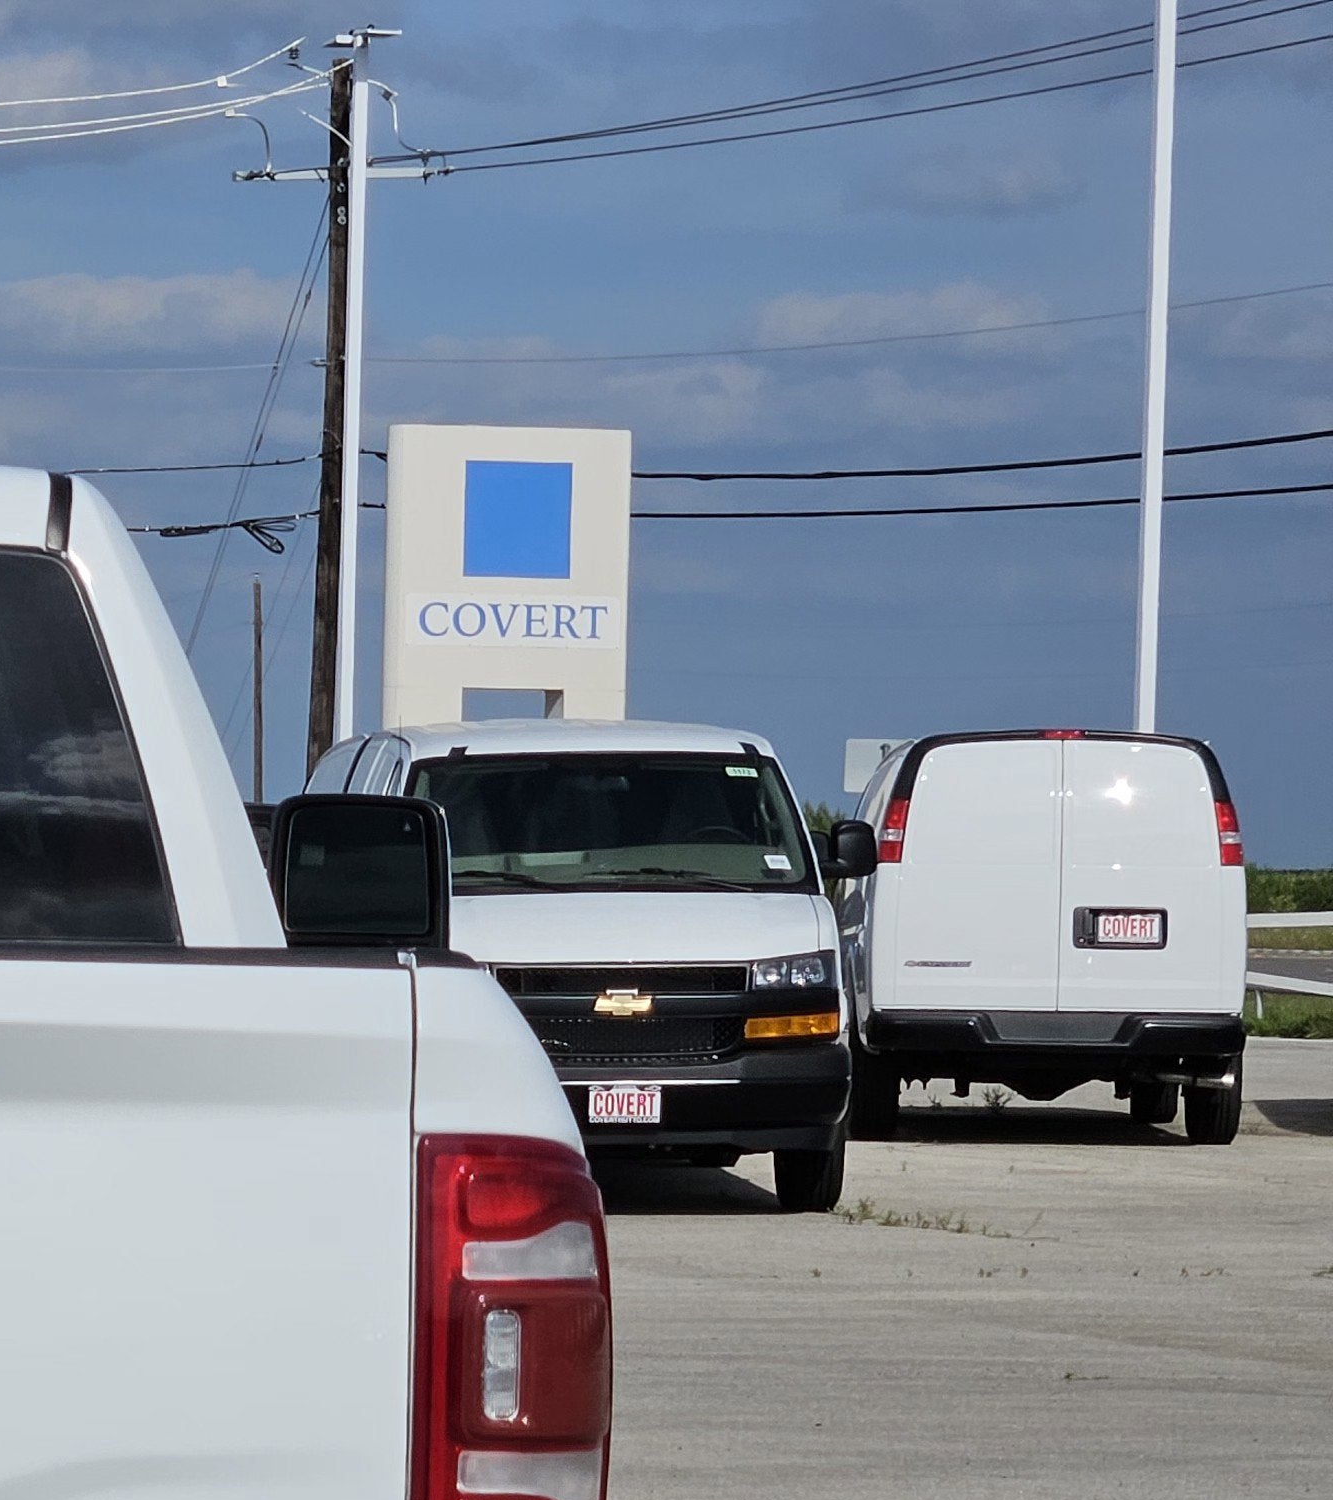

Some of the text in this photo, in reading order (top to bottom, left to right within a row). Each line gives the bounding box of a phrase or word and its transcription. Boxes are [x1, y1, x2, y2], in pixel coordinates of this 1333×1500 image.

[419, 602, 608, 639] COVERT
[1103, 918, 1154, 937] COVERT
[594, 1093, 655, 1115] COVERT
